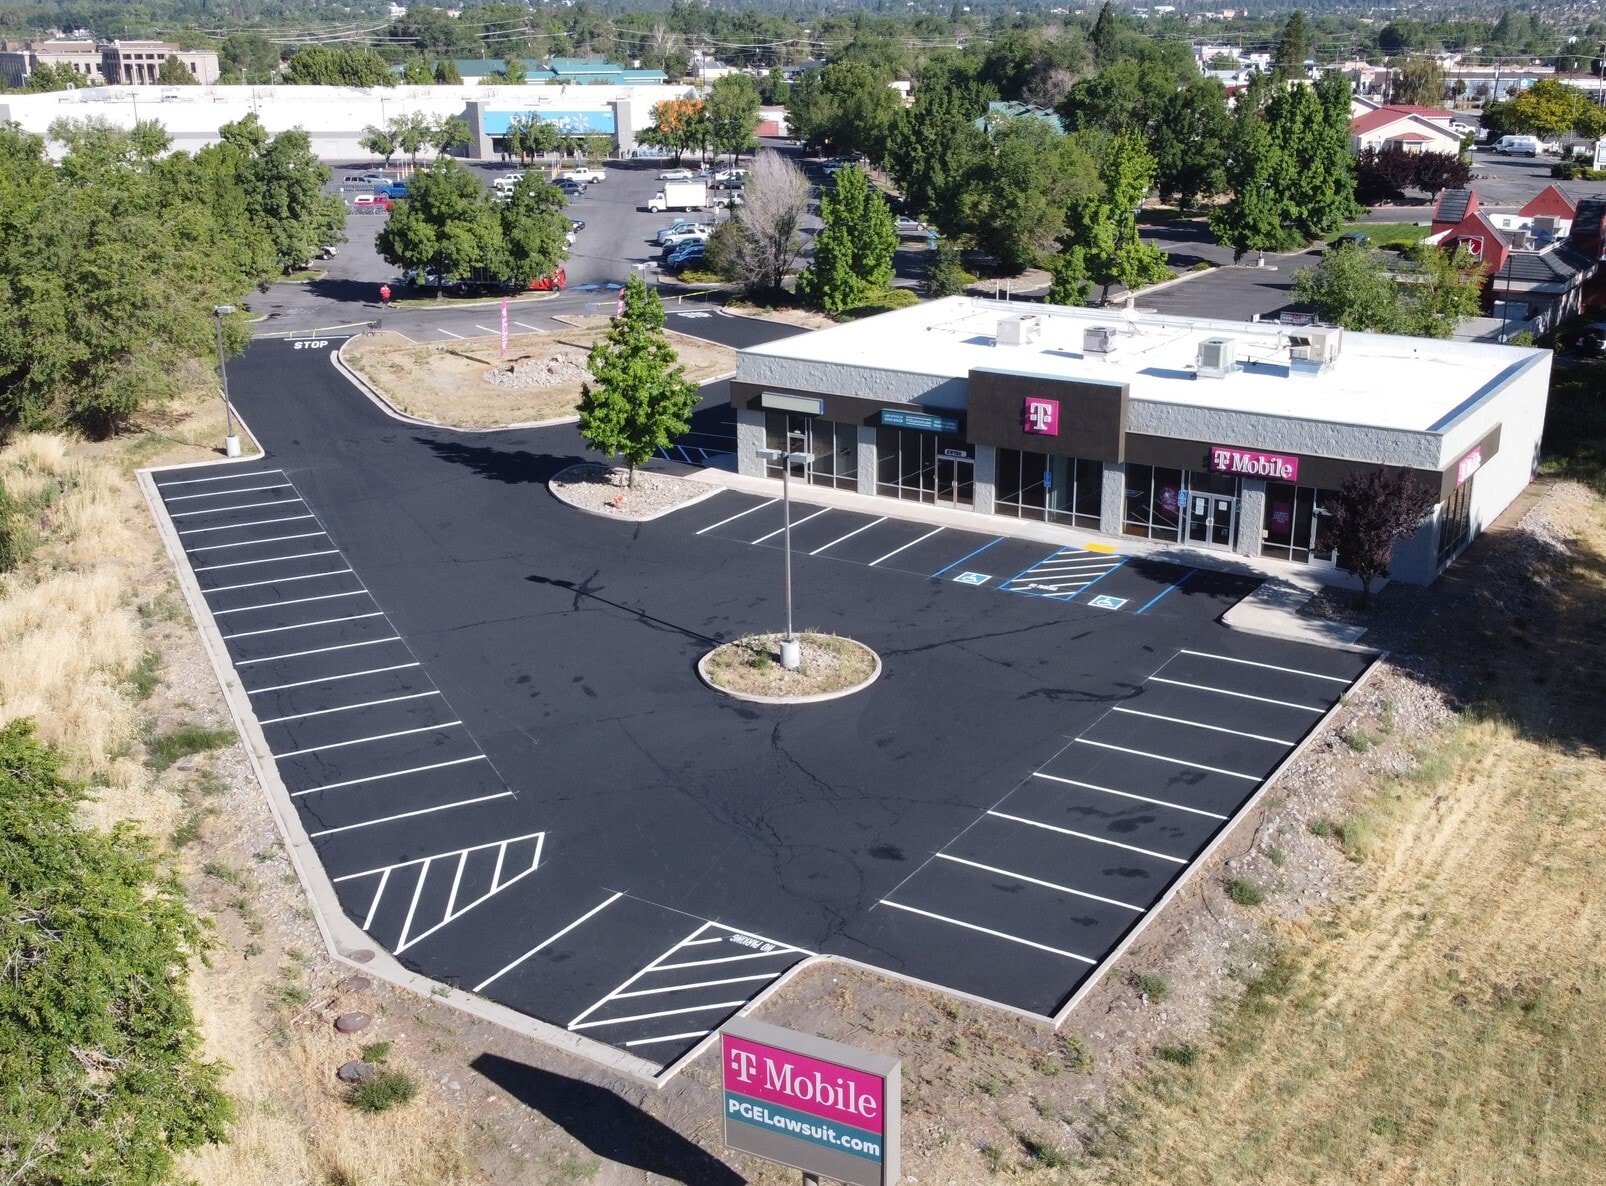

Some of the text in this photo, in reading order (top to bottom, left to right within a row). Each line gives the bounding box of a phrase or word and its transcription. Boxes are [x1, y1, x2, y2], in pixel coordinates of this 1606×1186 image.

[293, 340, 329, 350] STOP
[1029, 402, 1052, 431] T
[1214, 450, 1292, 479] T Mobile
[729, 934, 776, 952] NO PARKING
[731, 1048, 877, 1118] T Mobile
[728, 1098, 880, 1156] PGELawsuit.com
